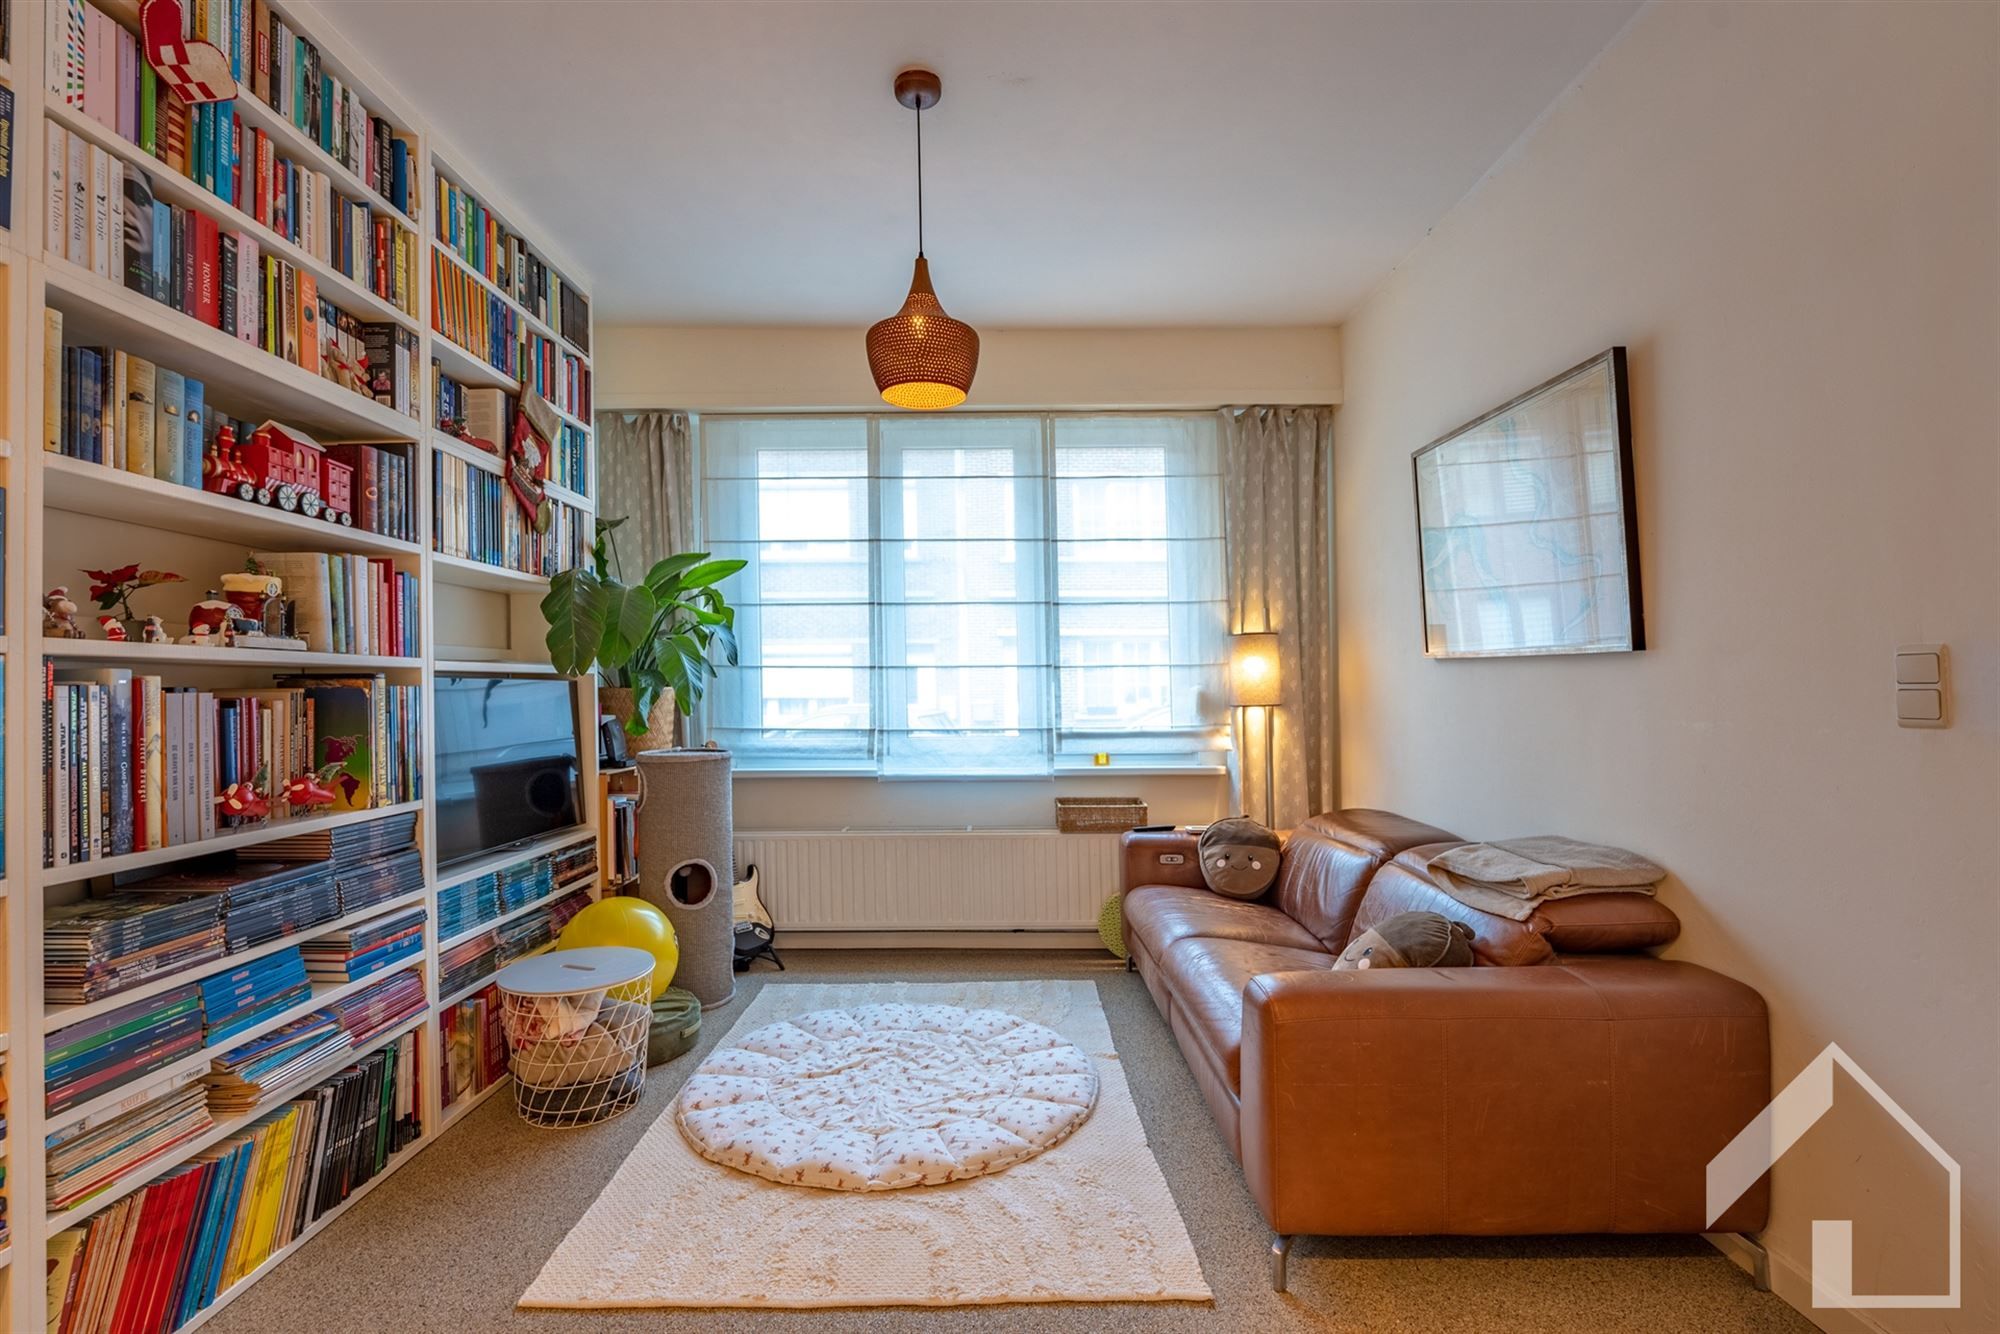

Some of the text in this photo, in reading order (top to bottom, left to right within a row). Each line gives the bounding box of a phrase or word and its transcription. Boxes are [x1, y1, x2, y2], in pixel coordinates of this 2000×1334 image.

[52, 185, 63, 232] Mythos
[74, 195, 84, 241] Helden
[97, 209, 107, 241] Troje
[187, 253, 195, 265] DE
[203, 261, 211, 304] HONGER
[80, 697, 88, 729] STAR
[80, 729, 88, 760] WARS
[120, 761, 128, 780] GAME
[137, 736, 147, 803] Pieter Bruegel
